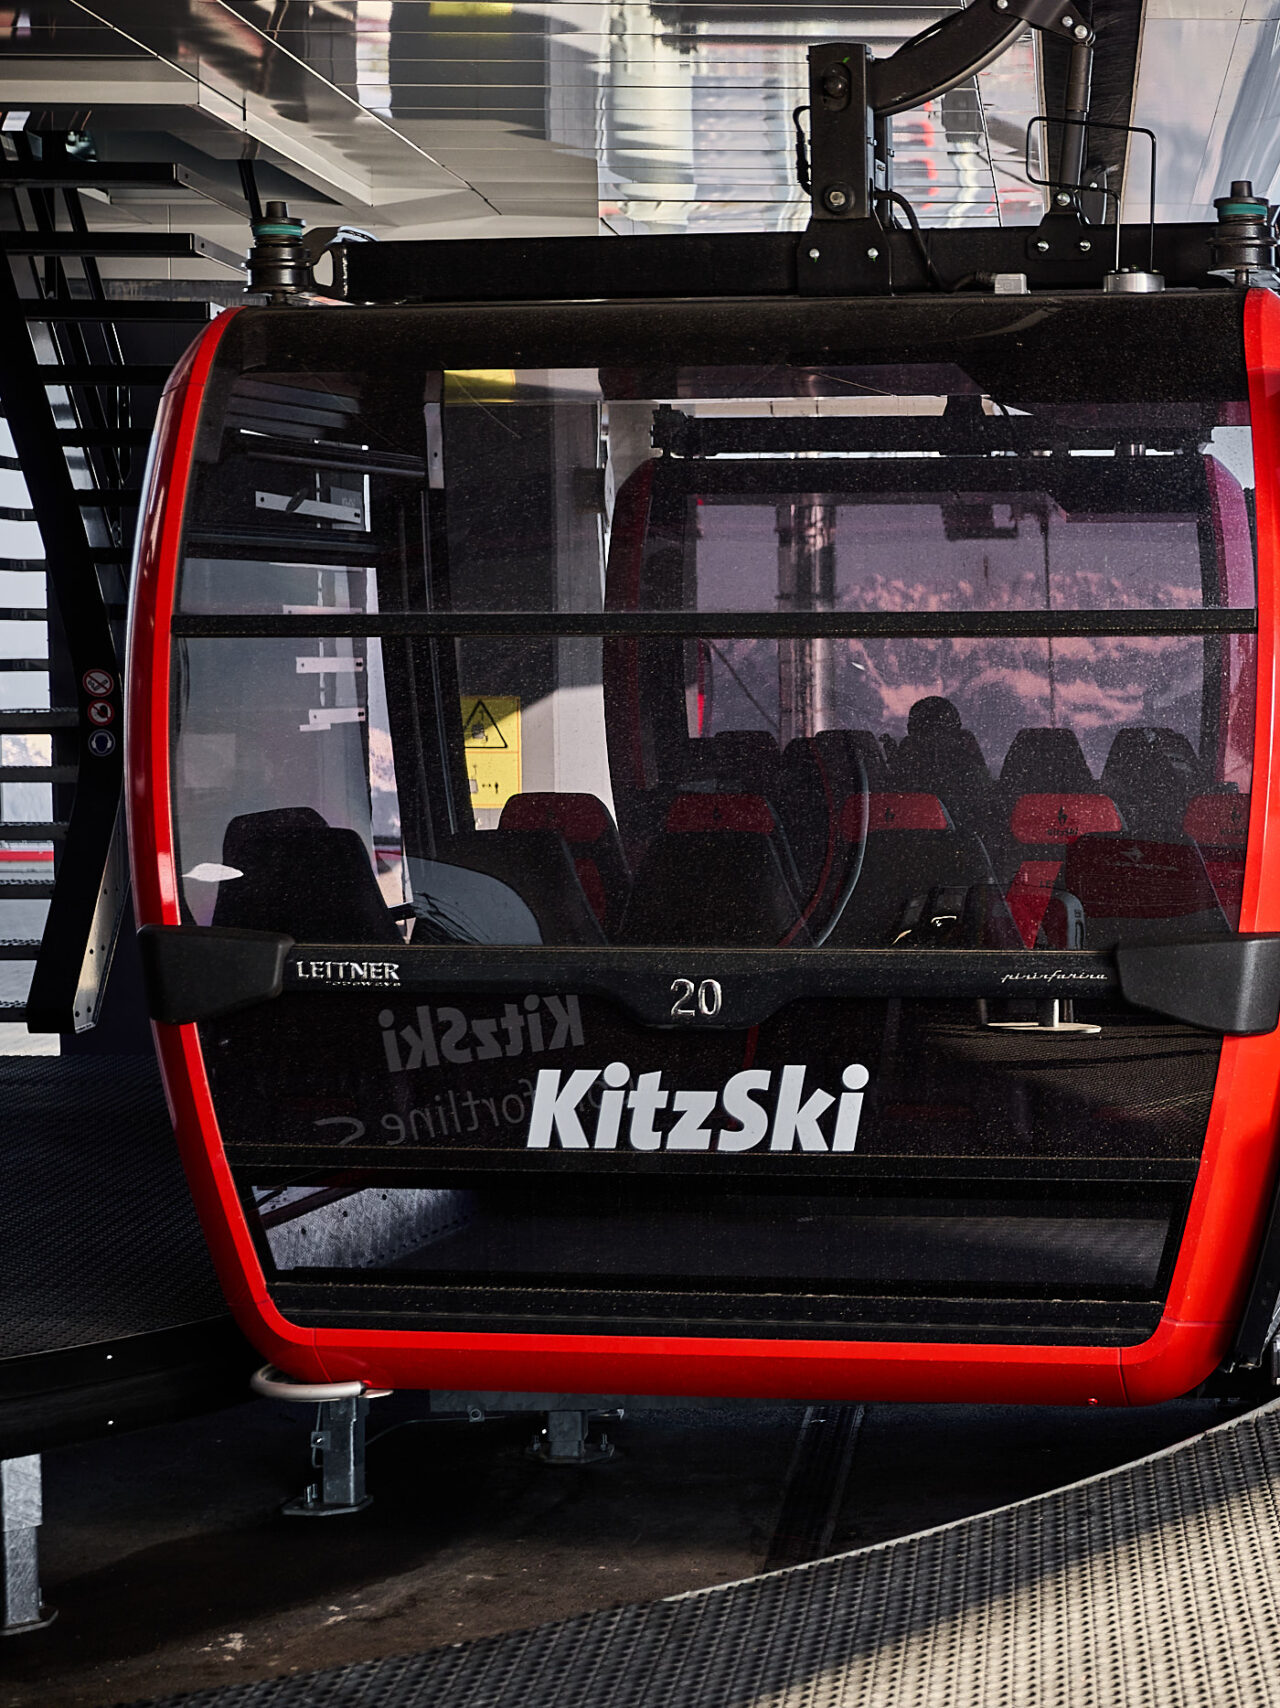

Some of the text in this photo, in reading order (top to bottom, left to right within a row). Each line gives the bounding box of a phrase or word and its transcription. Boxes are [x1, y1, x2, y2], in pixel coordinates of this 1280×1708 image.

[296, 961, 399, 980] LEITNER
[1000, 969, 1107, 983] pininfarina
[670, 978, 722, 1016] 20
[527, 1061, 870, 1152] KitzSki
